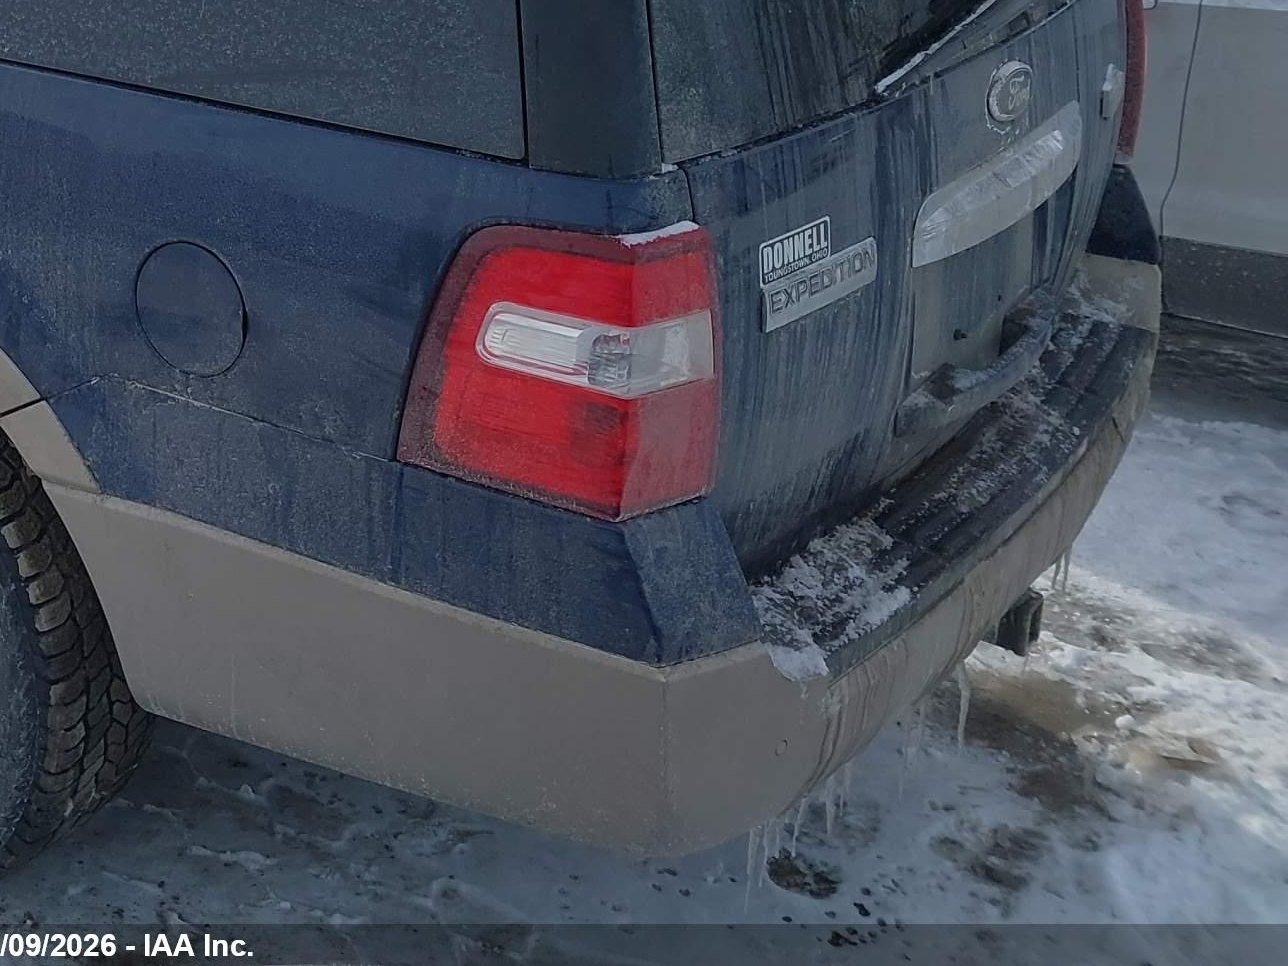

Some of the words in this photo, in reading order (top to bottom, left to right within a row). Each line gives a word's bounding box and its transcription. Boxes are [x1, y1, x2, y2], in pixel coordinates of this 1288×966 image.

[762, 222, 829, 274] DONNELL
[811, 248, 828, 262] OHIO
[769, 245, 876, 313] EXPEDITION
